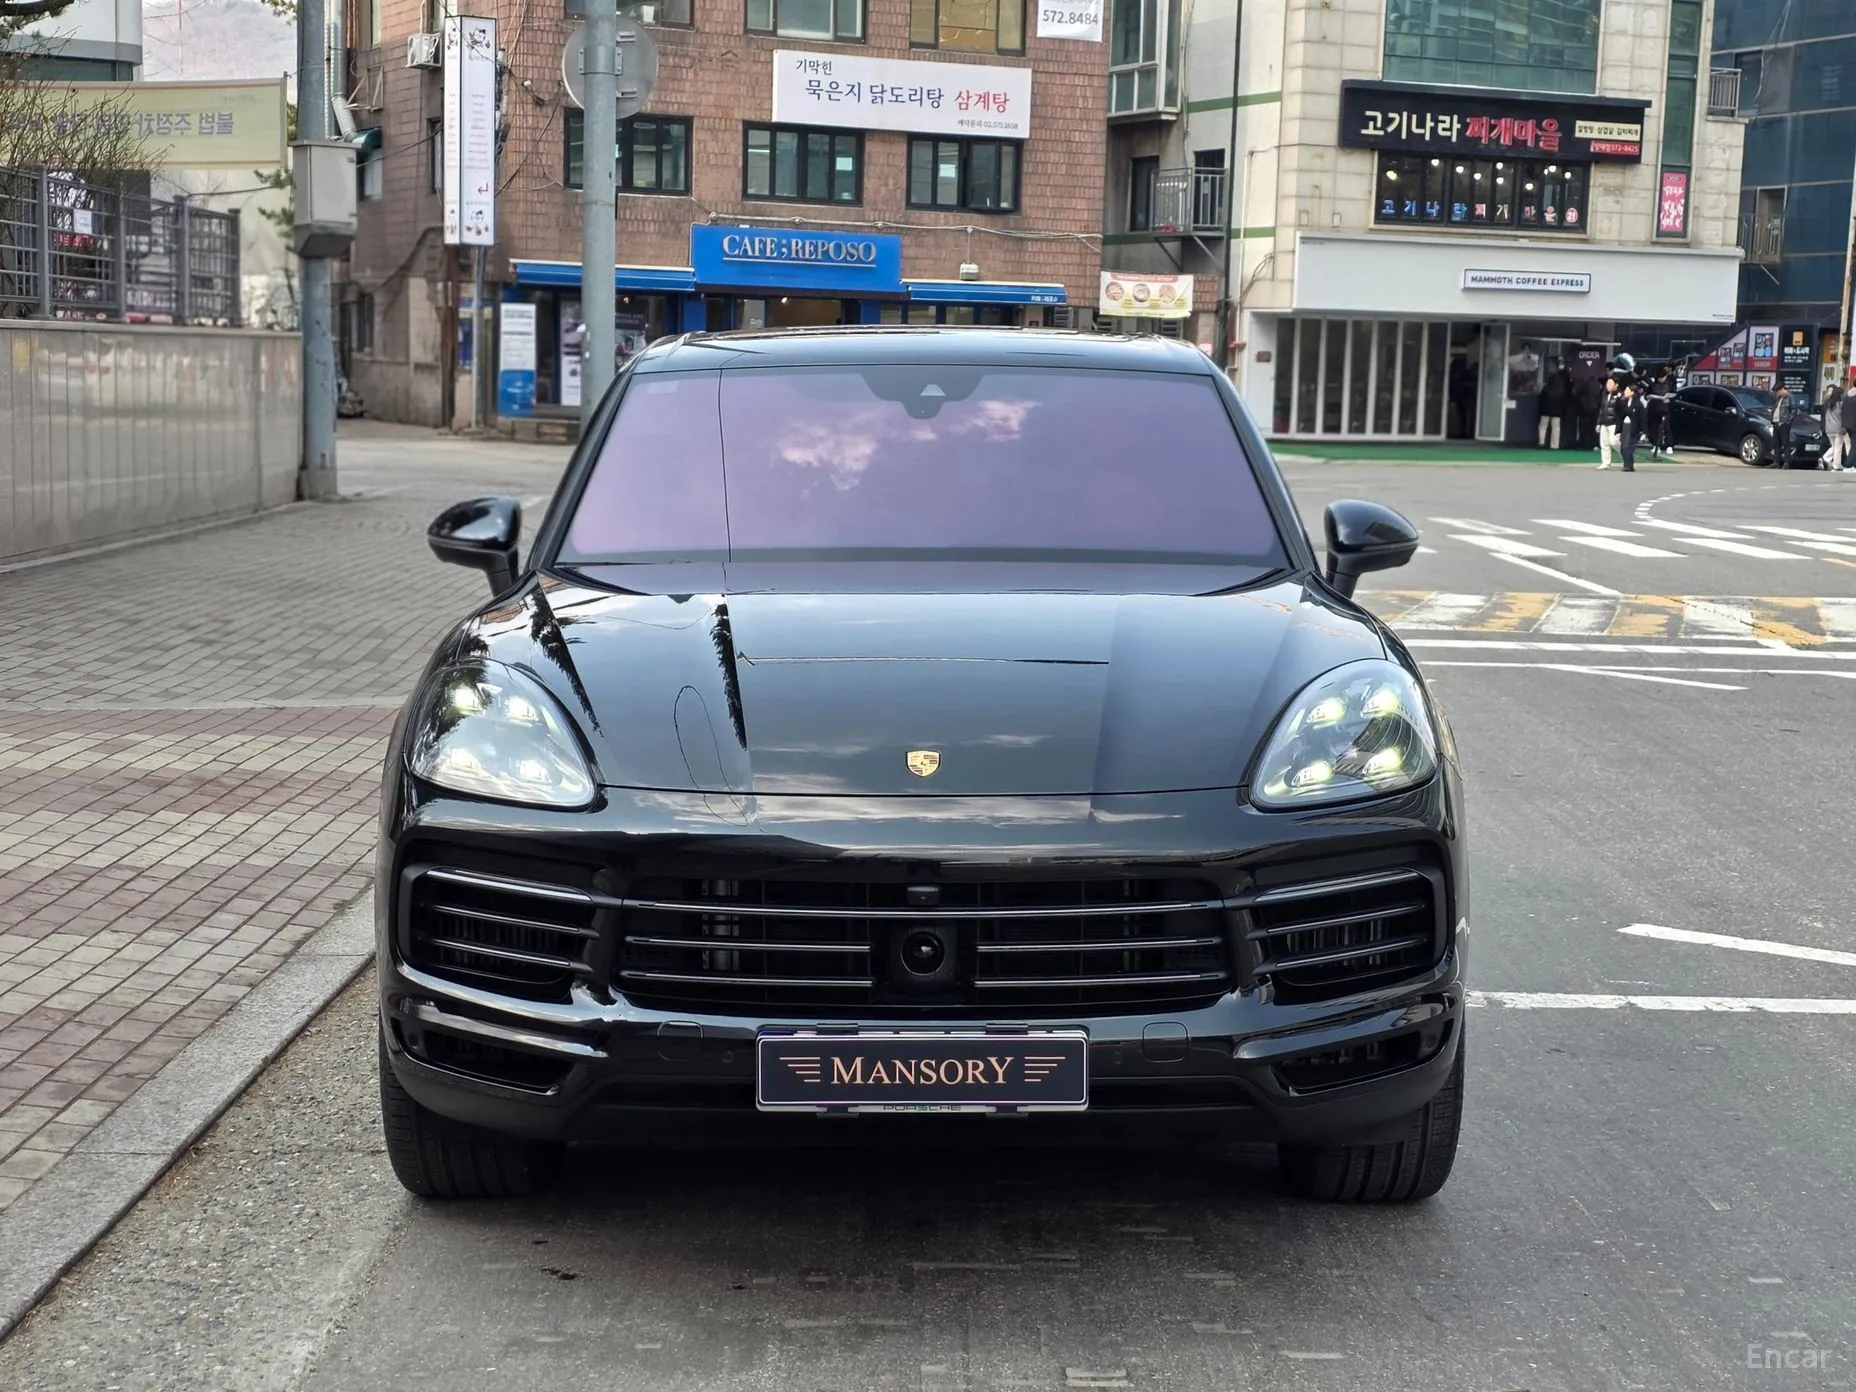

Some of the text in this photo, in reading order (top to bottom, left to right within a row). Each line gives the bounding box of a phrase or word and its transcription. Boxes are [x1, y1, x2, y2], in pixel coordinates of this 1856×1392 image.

[1042, 9, 1098, 26] 572.8484
[796, 59, 832, 75] 기막힌
[805, 79, 1010, 113] 묵은지 닭도리탕 삼계탕
[1360, 110, 1562, 152] 고기나라 찌개마을
[1471, 275, 1584, 287] MAMMOTH COFFEE EXPRESS
[1578, 351, 1600, 359] ORDER
